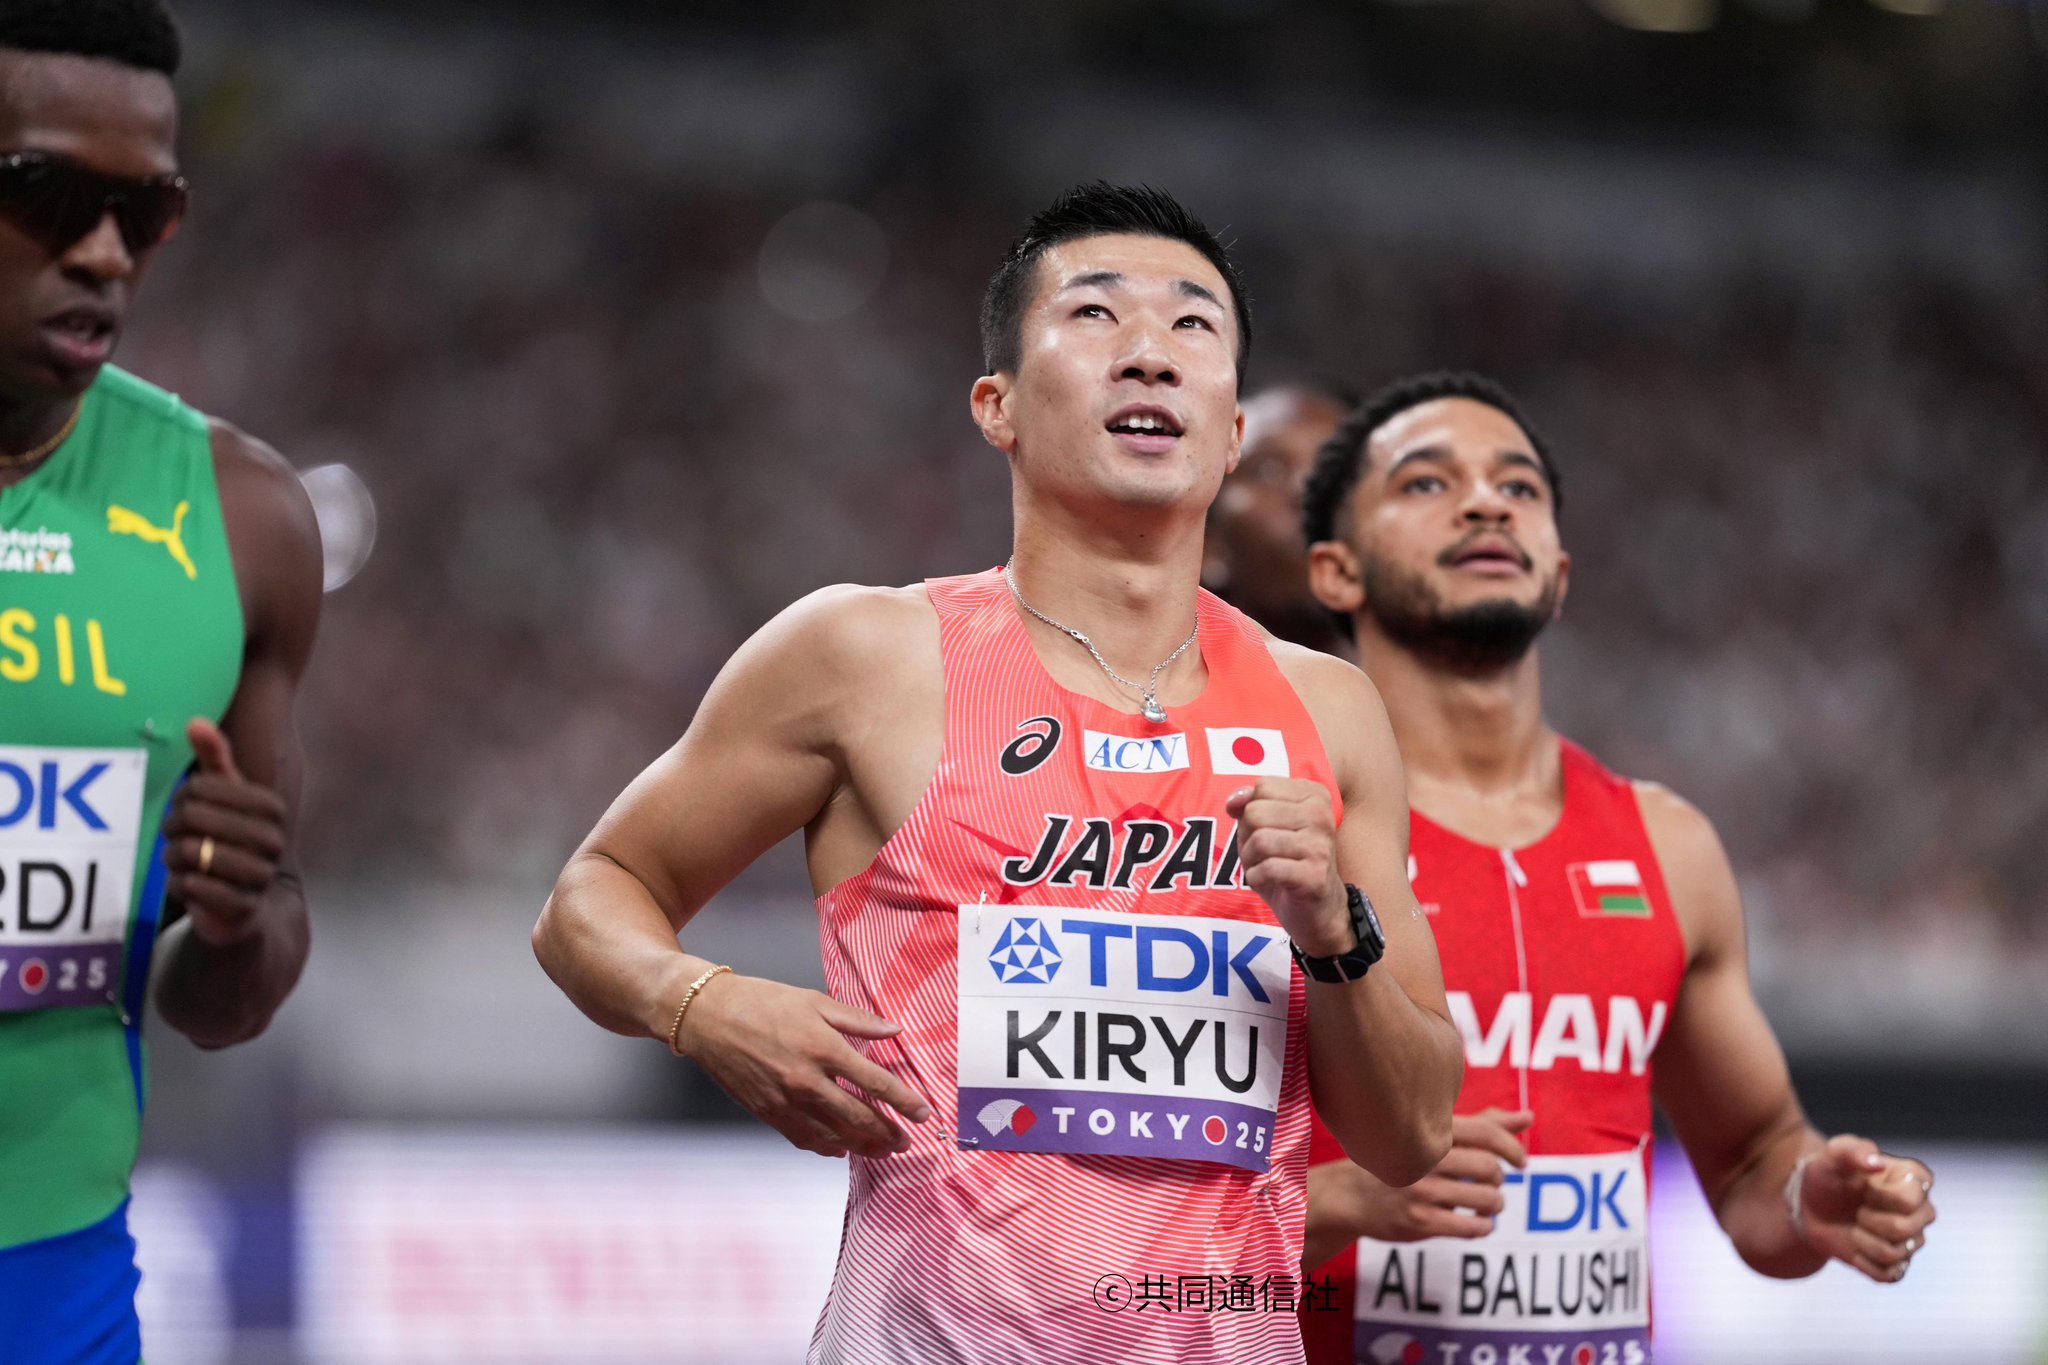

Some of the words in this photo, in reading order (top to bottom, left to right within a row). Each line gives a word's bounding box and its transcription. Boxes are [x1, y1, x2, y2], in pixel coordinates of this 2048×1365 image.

[1089, 736, 1181, 770] ACN
[0, 861, 97, 932] DI
[1061, 919, 1272, 1005] TDK
[1007, 1010, 1258, 1093] KIRYU
[1494, 1171, 1629, 1232] DK
[1374, 1249, 1440, 1315] AL
[1459, 1250, 1640, 1316] BALUSHI
